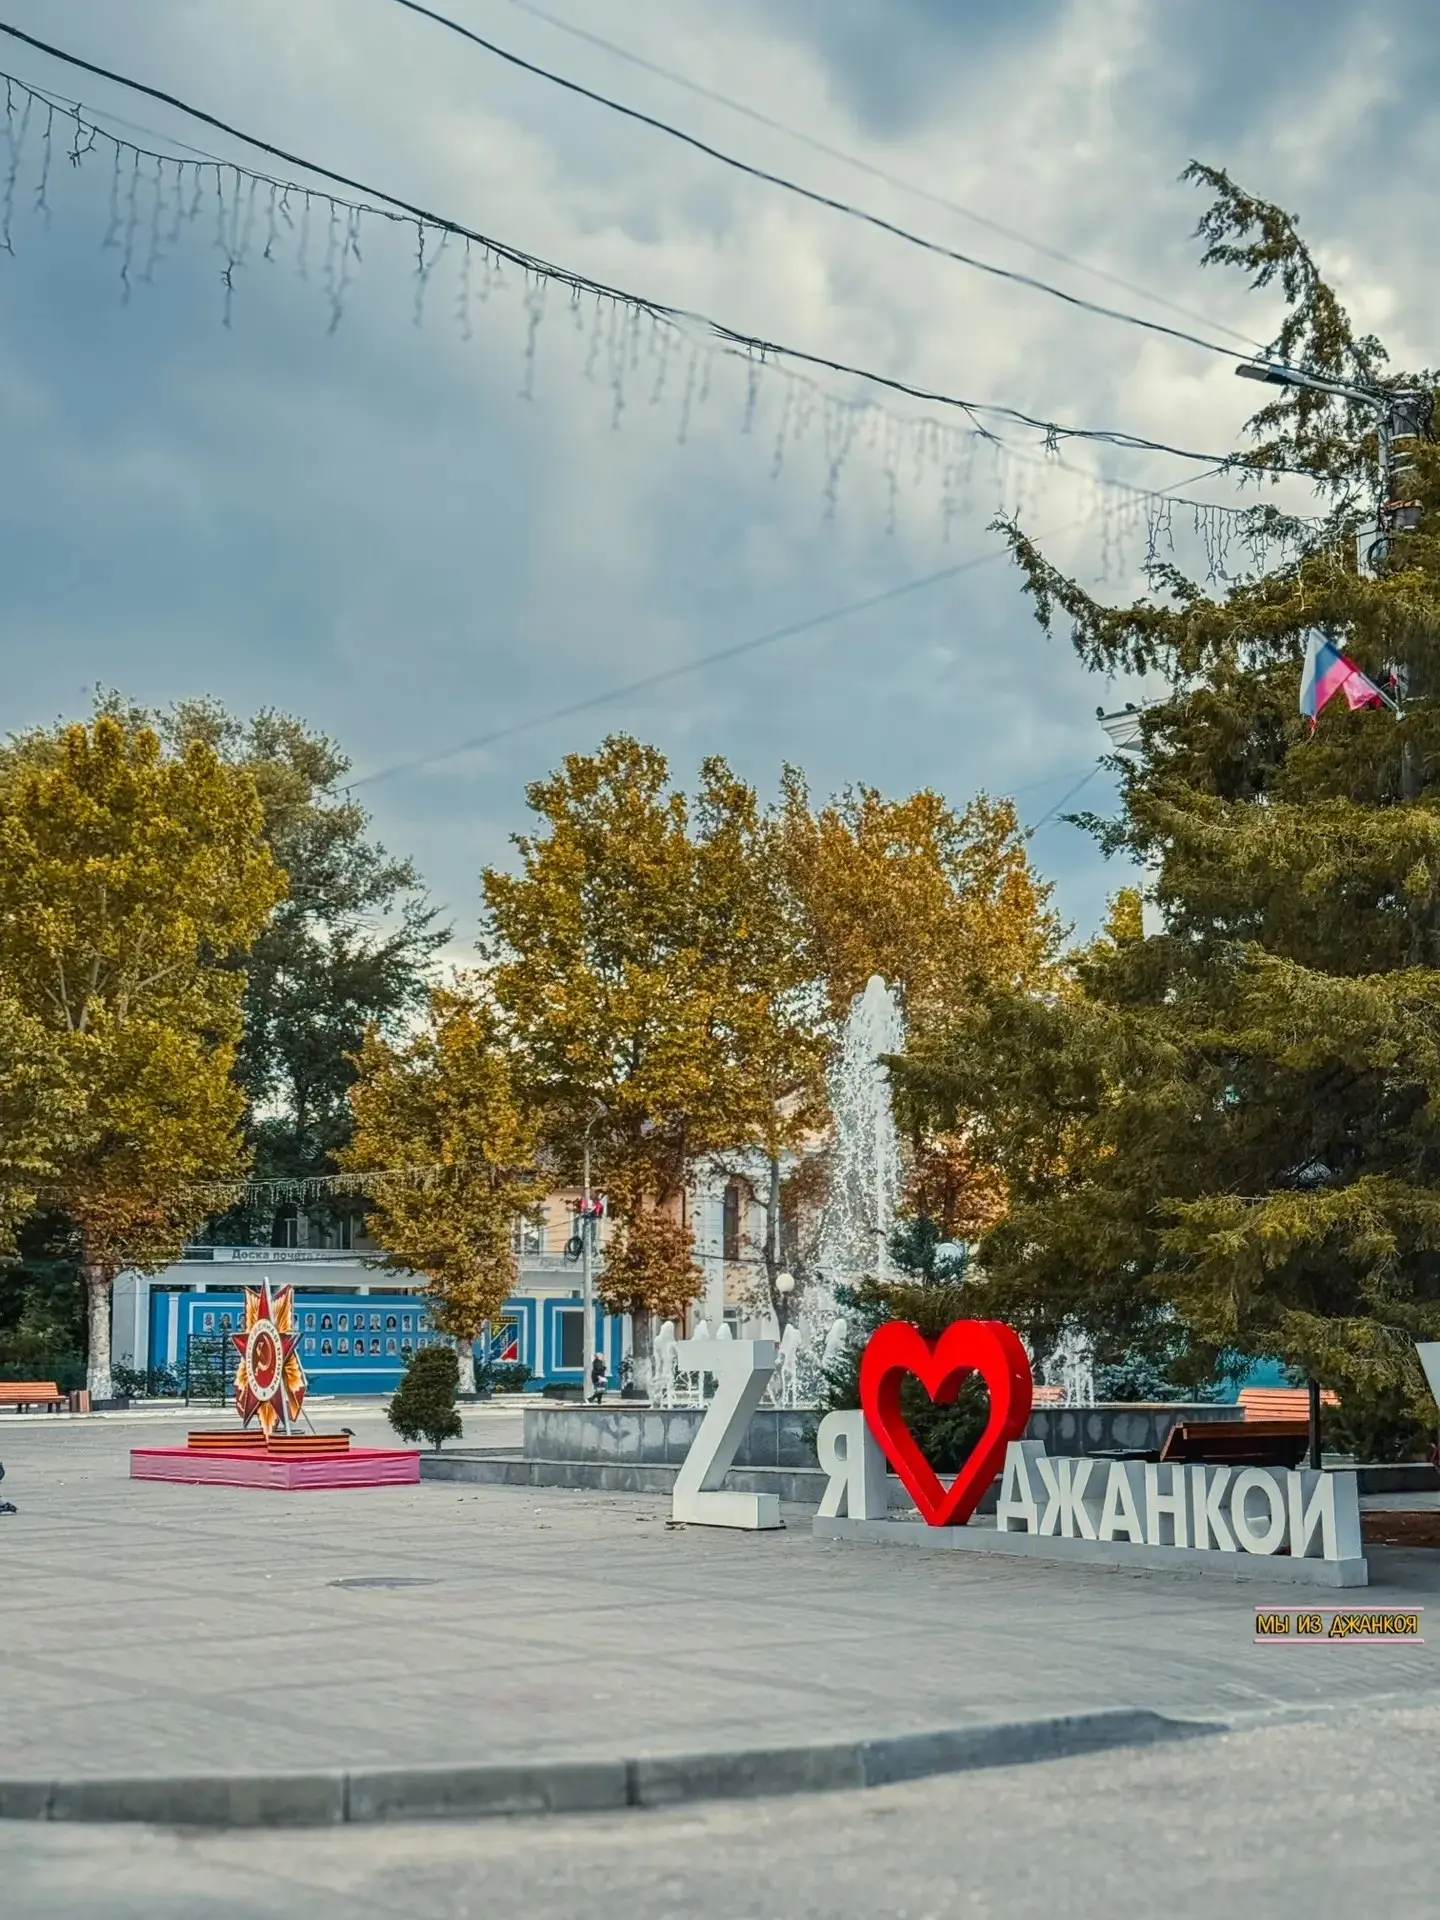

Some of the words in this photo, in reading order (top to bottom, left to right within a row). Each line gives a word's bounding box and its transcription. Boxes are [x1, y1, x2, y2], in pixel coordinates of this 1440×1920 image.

[231, 1249, 269, 1260] Доска
[673, 1339, 780, 1529] Z
[815, 1409, 885, 1520] Я
